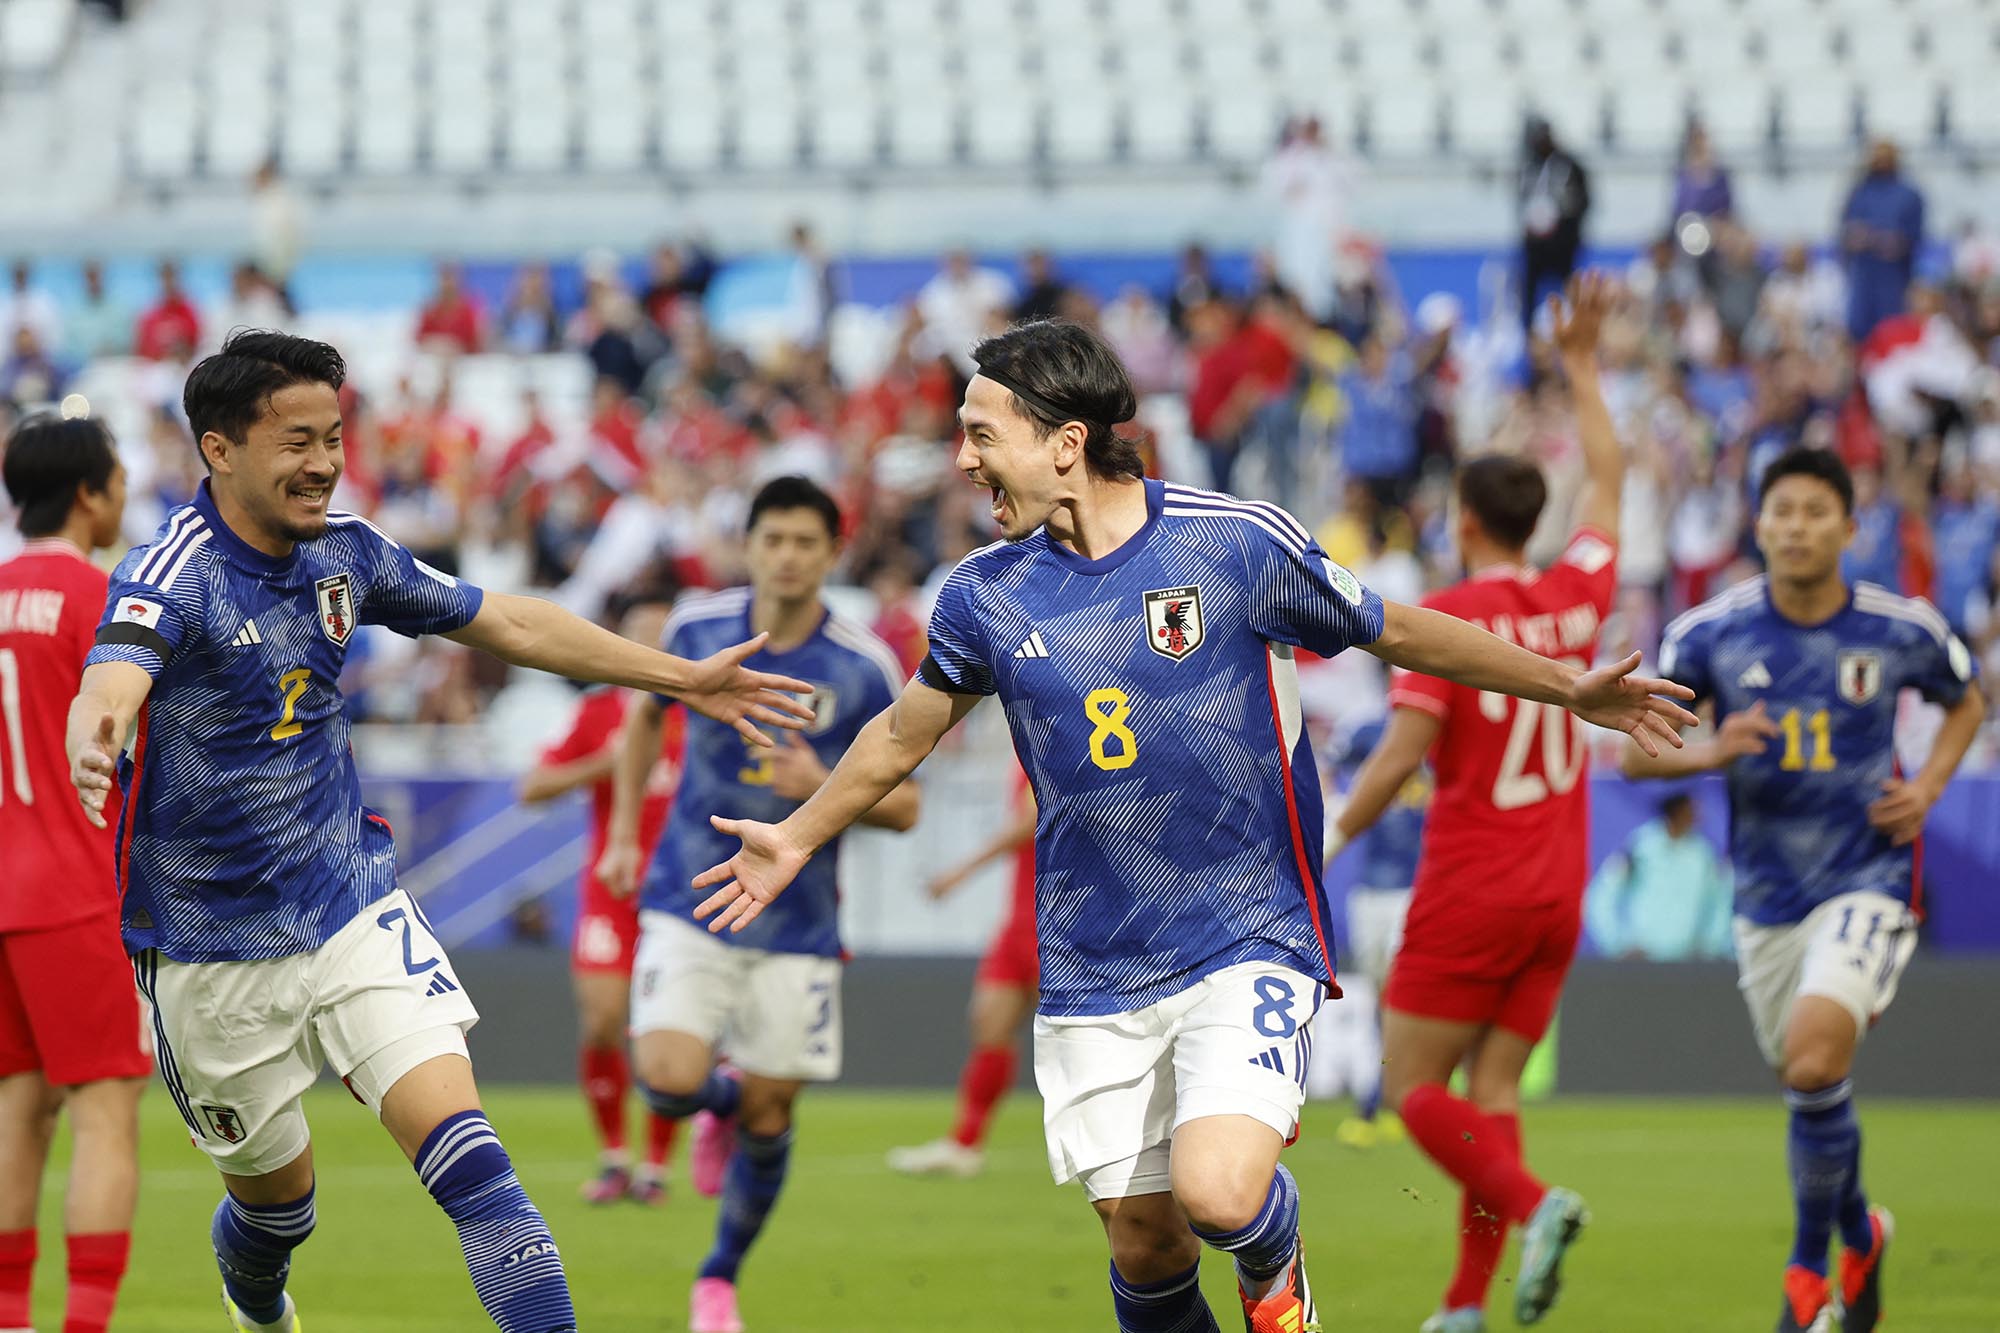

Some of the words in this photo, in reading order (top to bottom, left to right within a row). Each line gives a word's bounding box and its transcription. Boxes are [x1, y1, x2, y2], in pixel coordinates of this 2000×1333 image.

[322, 577, 341, 588] JAPAN
[1157, 589, 1186, 599] JAPAN
[271, 668, 312, 741] 2
[1084, 687, 1138, 771] 8
[1779, 707, 1837, 773] 11
[376, 907, 441, 977] 2
[1252, 975, 1297, 1039] 8
[504, 1242, 561, 1269] JAP
